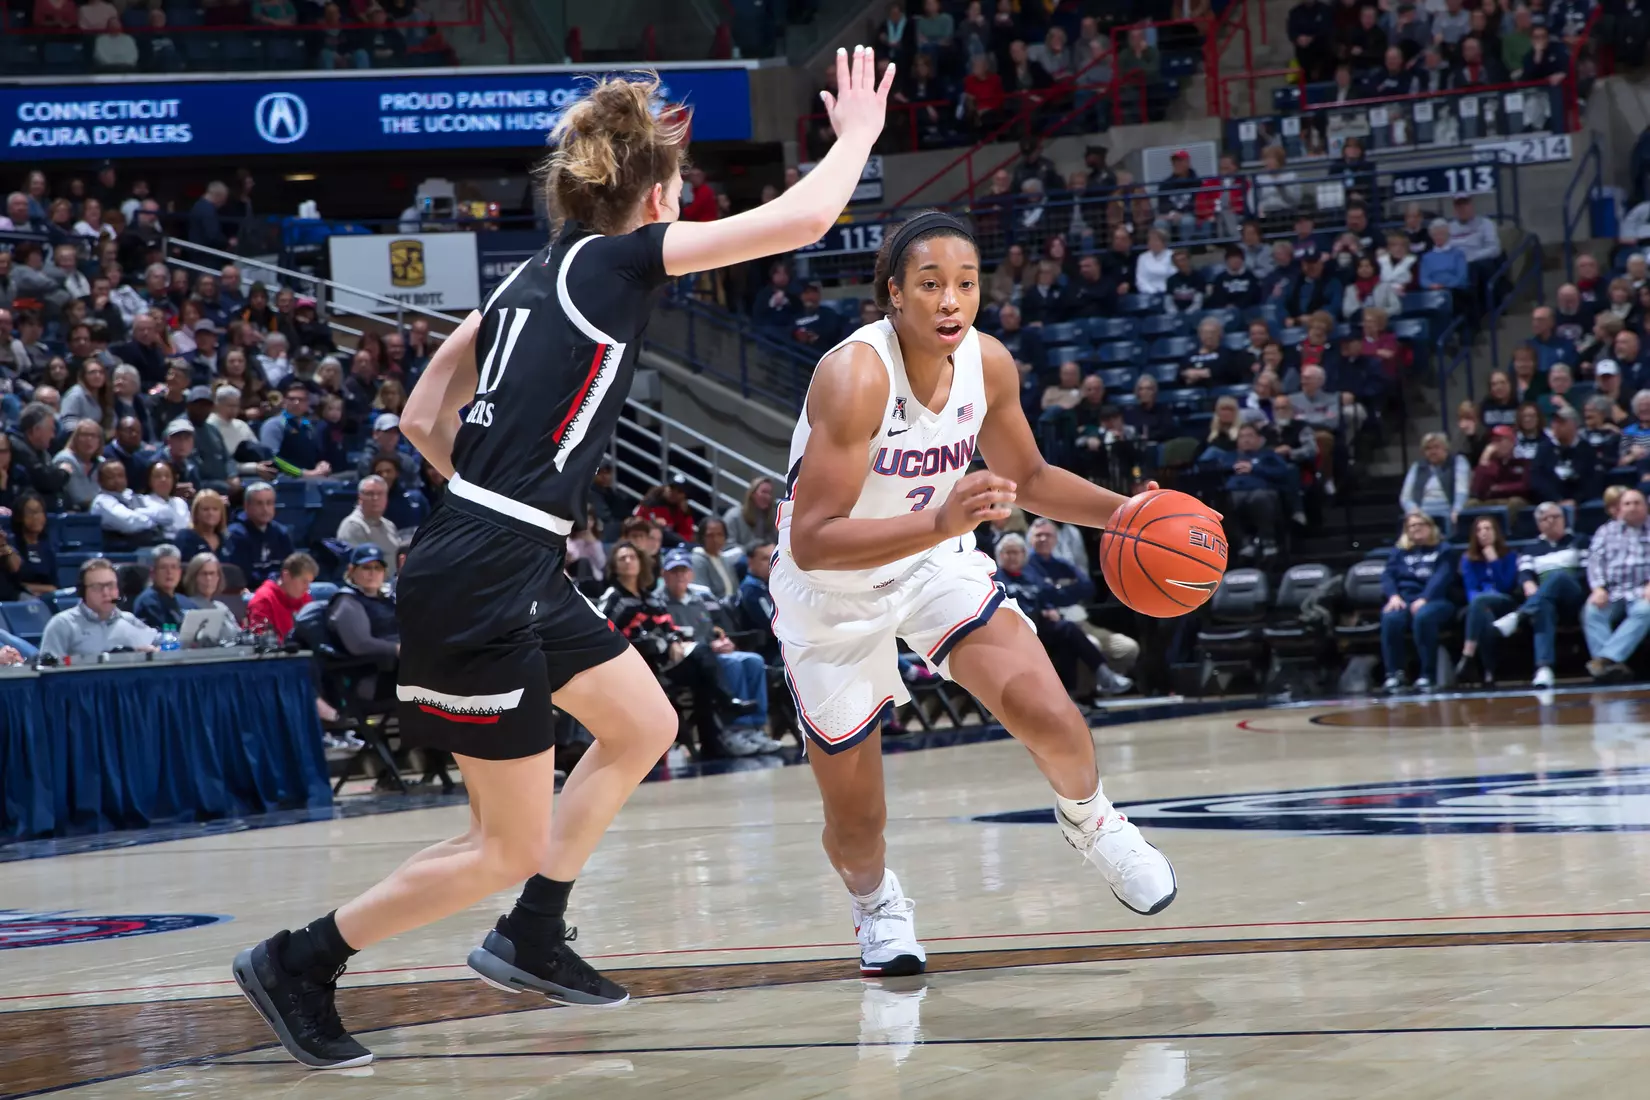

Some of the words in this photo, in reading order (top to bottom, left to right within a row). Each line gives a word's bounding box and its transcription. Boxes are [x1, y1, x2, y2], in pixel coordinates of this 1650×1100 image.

[17, 99, 182, 121] CONNECTICUT
[380, 92, 454, 110] PROUD
[456, 90, 549, 108] PARTNER
[9, 127, 91, 147] ACURA
[92, 123, 193, 144] DEALERS
[380, 115, 420, 133] THE
[424, 113, 502, 132] UCONN
[1521, 138, 1567, 163] 214
[1394, 177, 1429, 194] SEC
[1445, 165, 1494, 193] 113
[840, 224, 884, 251] 113
[476, 308, 532, 394] 11
[873, 434, 975, 478] UCONN
[1188, 529, 1228, 560] ELITE
